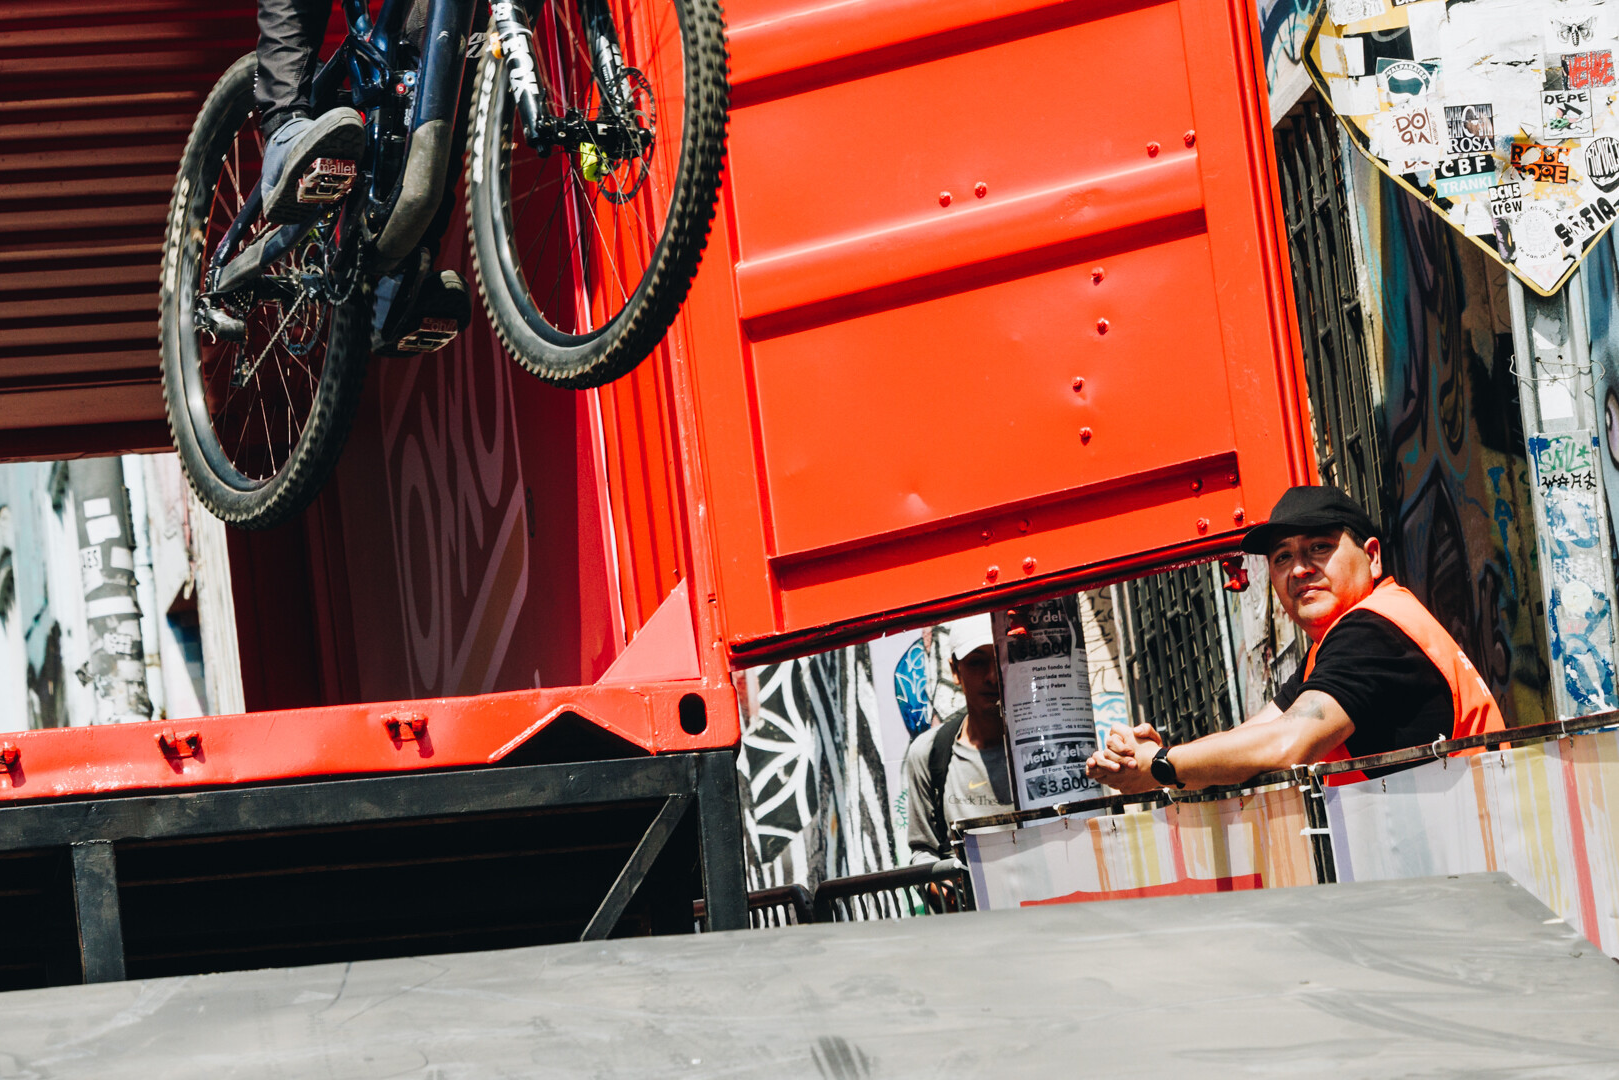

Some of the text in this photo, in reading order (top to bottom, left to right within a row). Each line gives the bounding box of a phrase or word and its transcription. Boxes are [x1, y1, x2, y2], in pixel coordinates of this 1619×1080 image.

[1544, 92, 1589, 105] DEPE
[1447, 136, 1495, 153] ROSA
[1440, 155, 1487, 177] CBF
[1440, 175, 1494, 194] TRANKI
[1493, 200, 1522, 215] crew
[1555, 197, 1617, 248] SFIA
[1062, 744, 1080, 758] del
